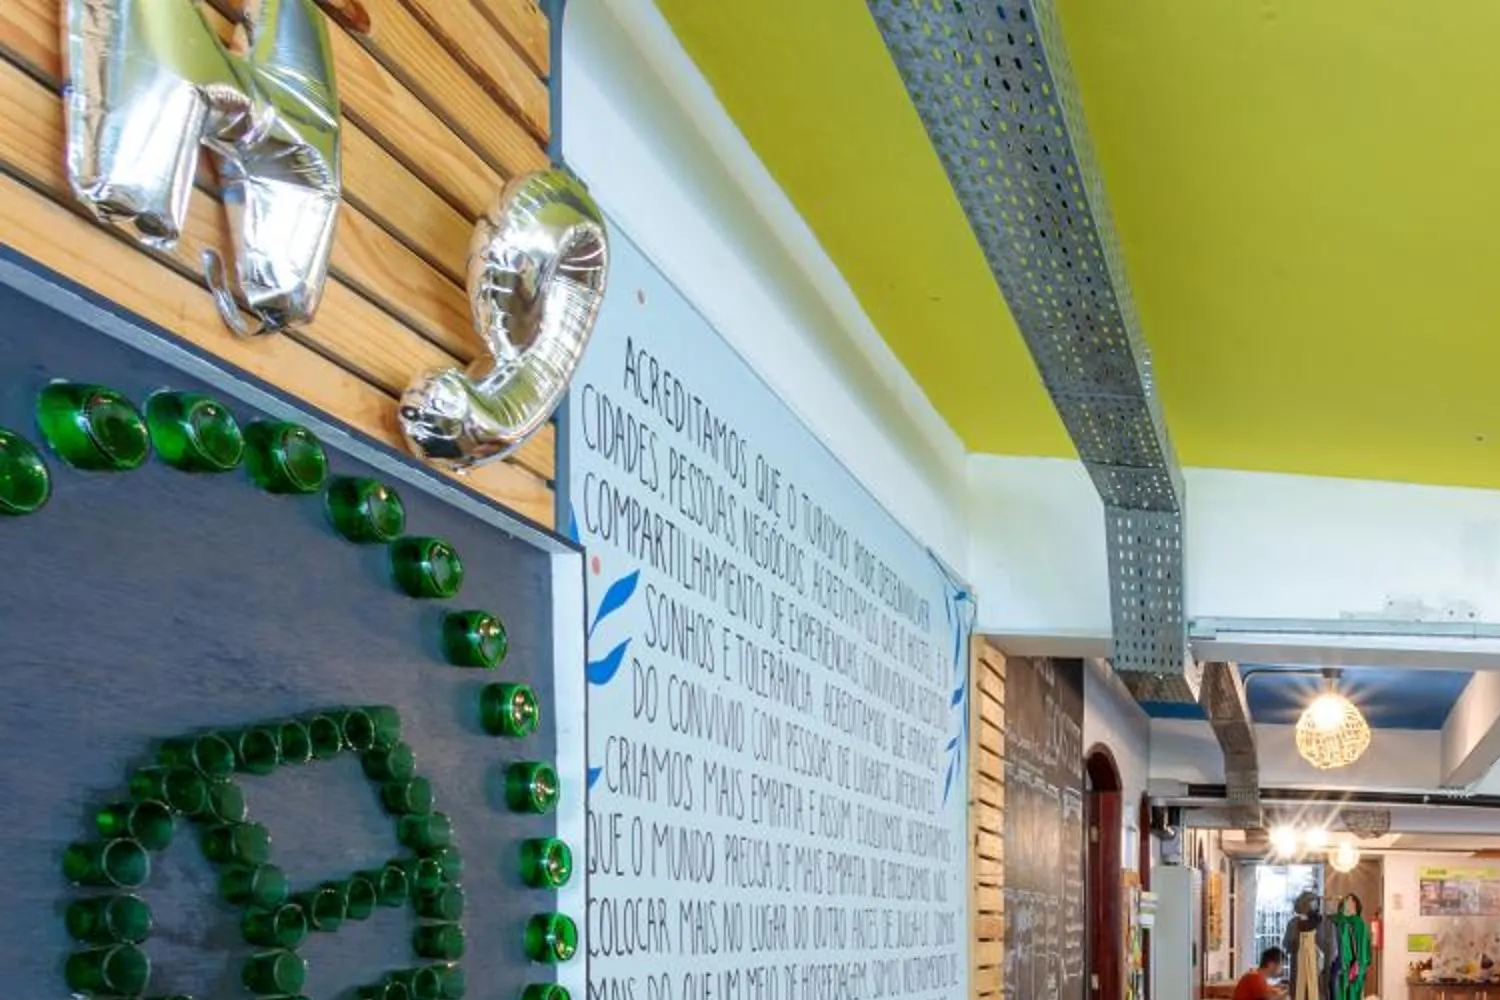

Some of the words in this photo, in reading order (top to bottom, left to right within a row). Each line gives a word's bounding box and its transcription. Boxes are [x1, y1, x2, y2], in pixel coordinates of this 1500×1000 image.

[623, 332, 747, 489] ACREDITAMOS
[584, 469, 764, 632] COMPARTILHAMENTO
[644, 583, 714, 675] SONHOS
[723, 625, 730, 681] E
[632, 661, 658, 726] DO
[667, 674, 744, 756] CONVÍVIO
[605, 734, 692, 811] CRIAMOS
[703, 760, 744, 821] MAIS
[587, 810, 624, 877] QUE
[631, 818, 642, 878] O
[651, 822, 714, 882] MUNDO
[587, 898, 670, 956] COLOCAR
[679, 901, 717, 954] MAIS
[723, 902, 743, 953] NO
